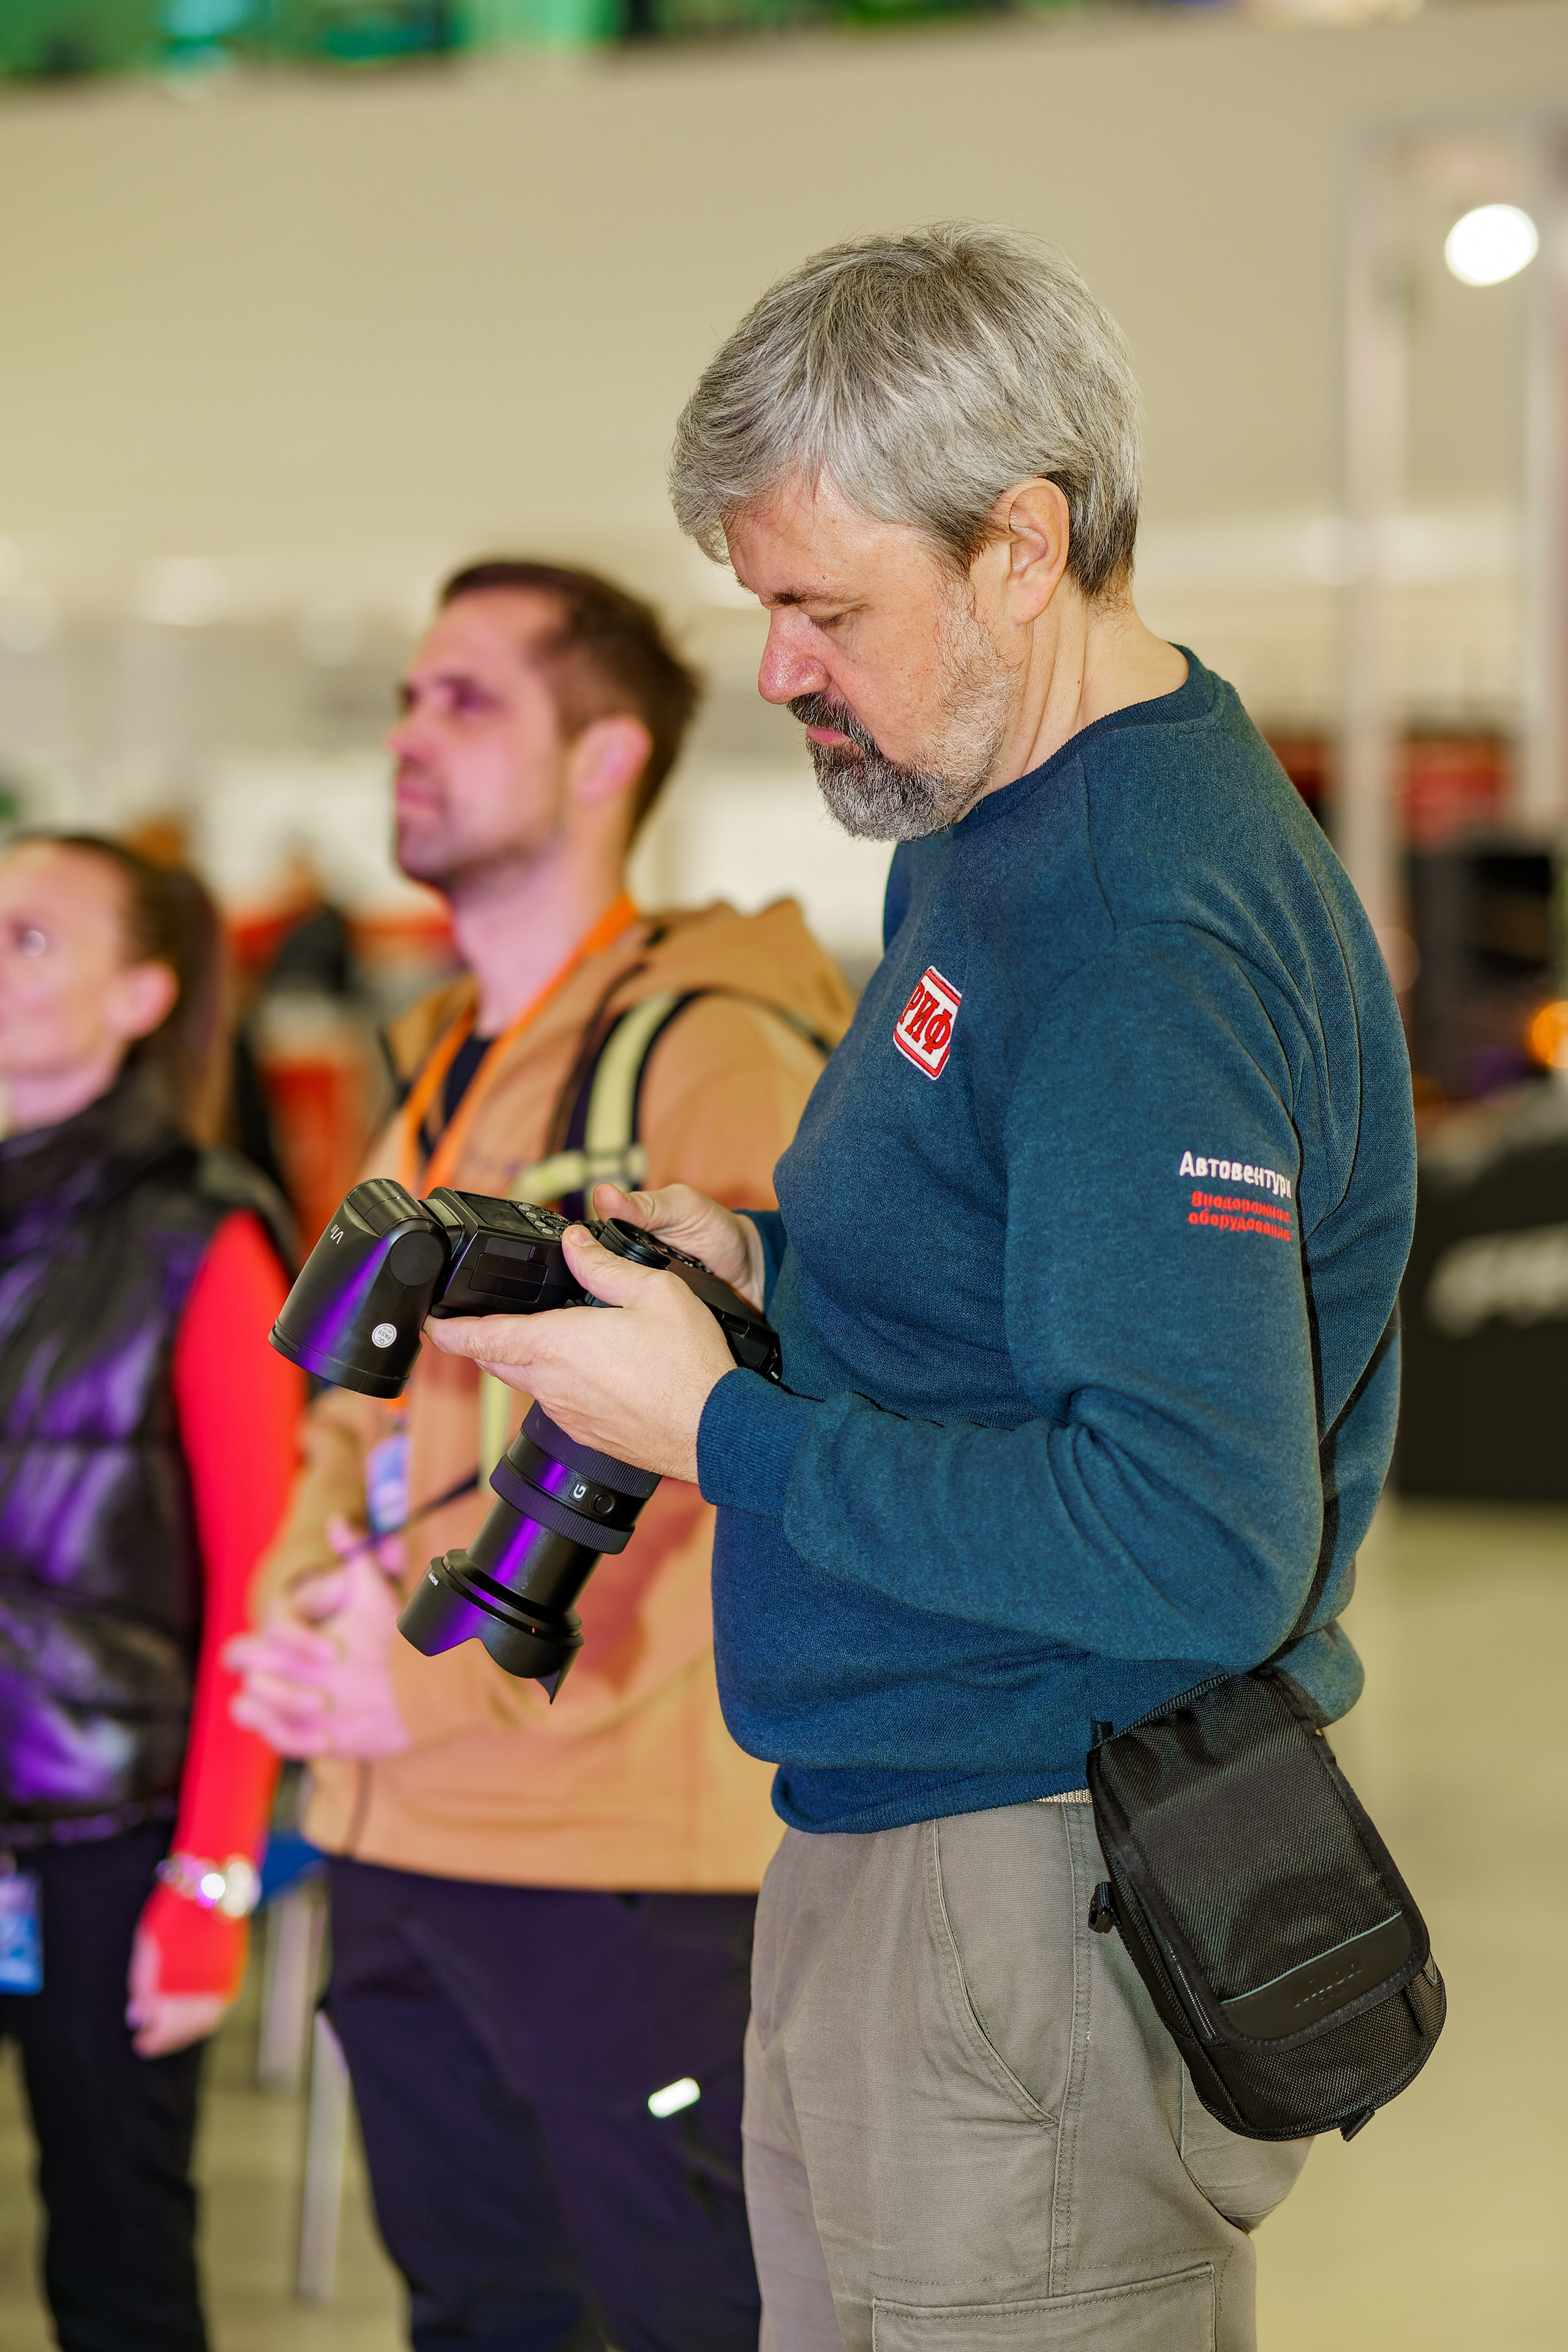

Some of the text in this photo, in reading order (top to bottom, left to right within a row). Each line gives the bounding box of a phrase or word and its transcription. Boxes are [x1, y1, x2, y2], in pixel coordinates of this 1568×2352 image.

[899, 982, 952, 1055] РИФ
[378, 1329, 391, 1340] PASS
[573, 1483, 586, 1499] G
